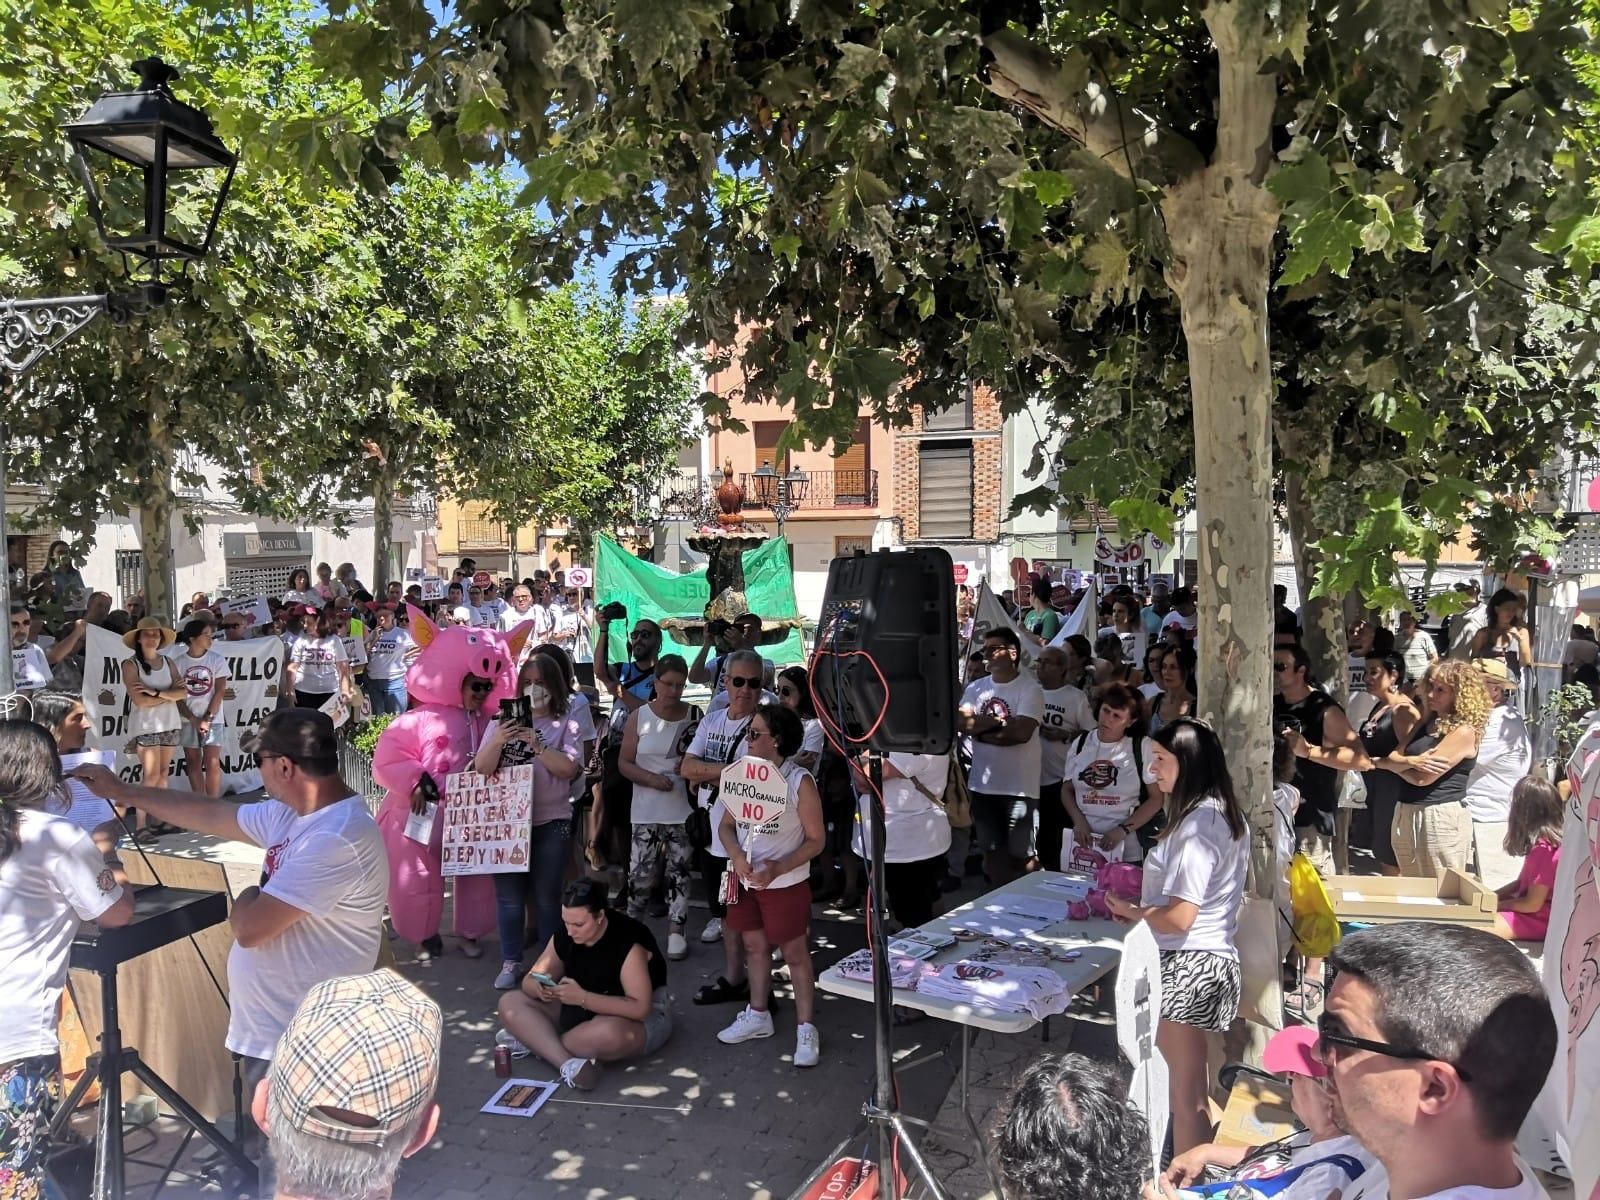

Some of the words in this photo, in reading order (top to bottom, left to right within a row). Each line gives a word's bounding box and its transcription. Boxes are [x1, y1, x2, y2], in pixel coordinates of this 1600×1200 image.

[275, 538, 296, 549] DENTAL
[1114, 543, 1142, 563] NO
[745, 762, 769, 782] NO
[742, 802, 764, 821] NO
[818, 1170, 848, 1200] TOP
